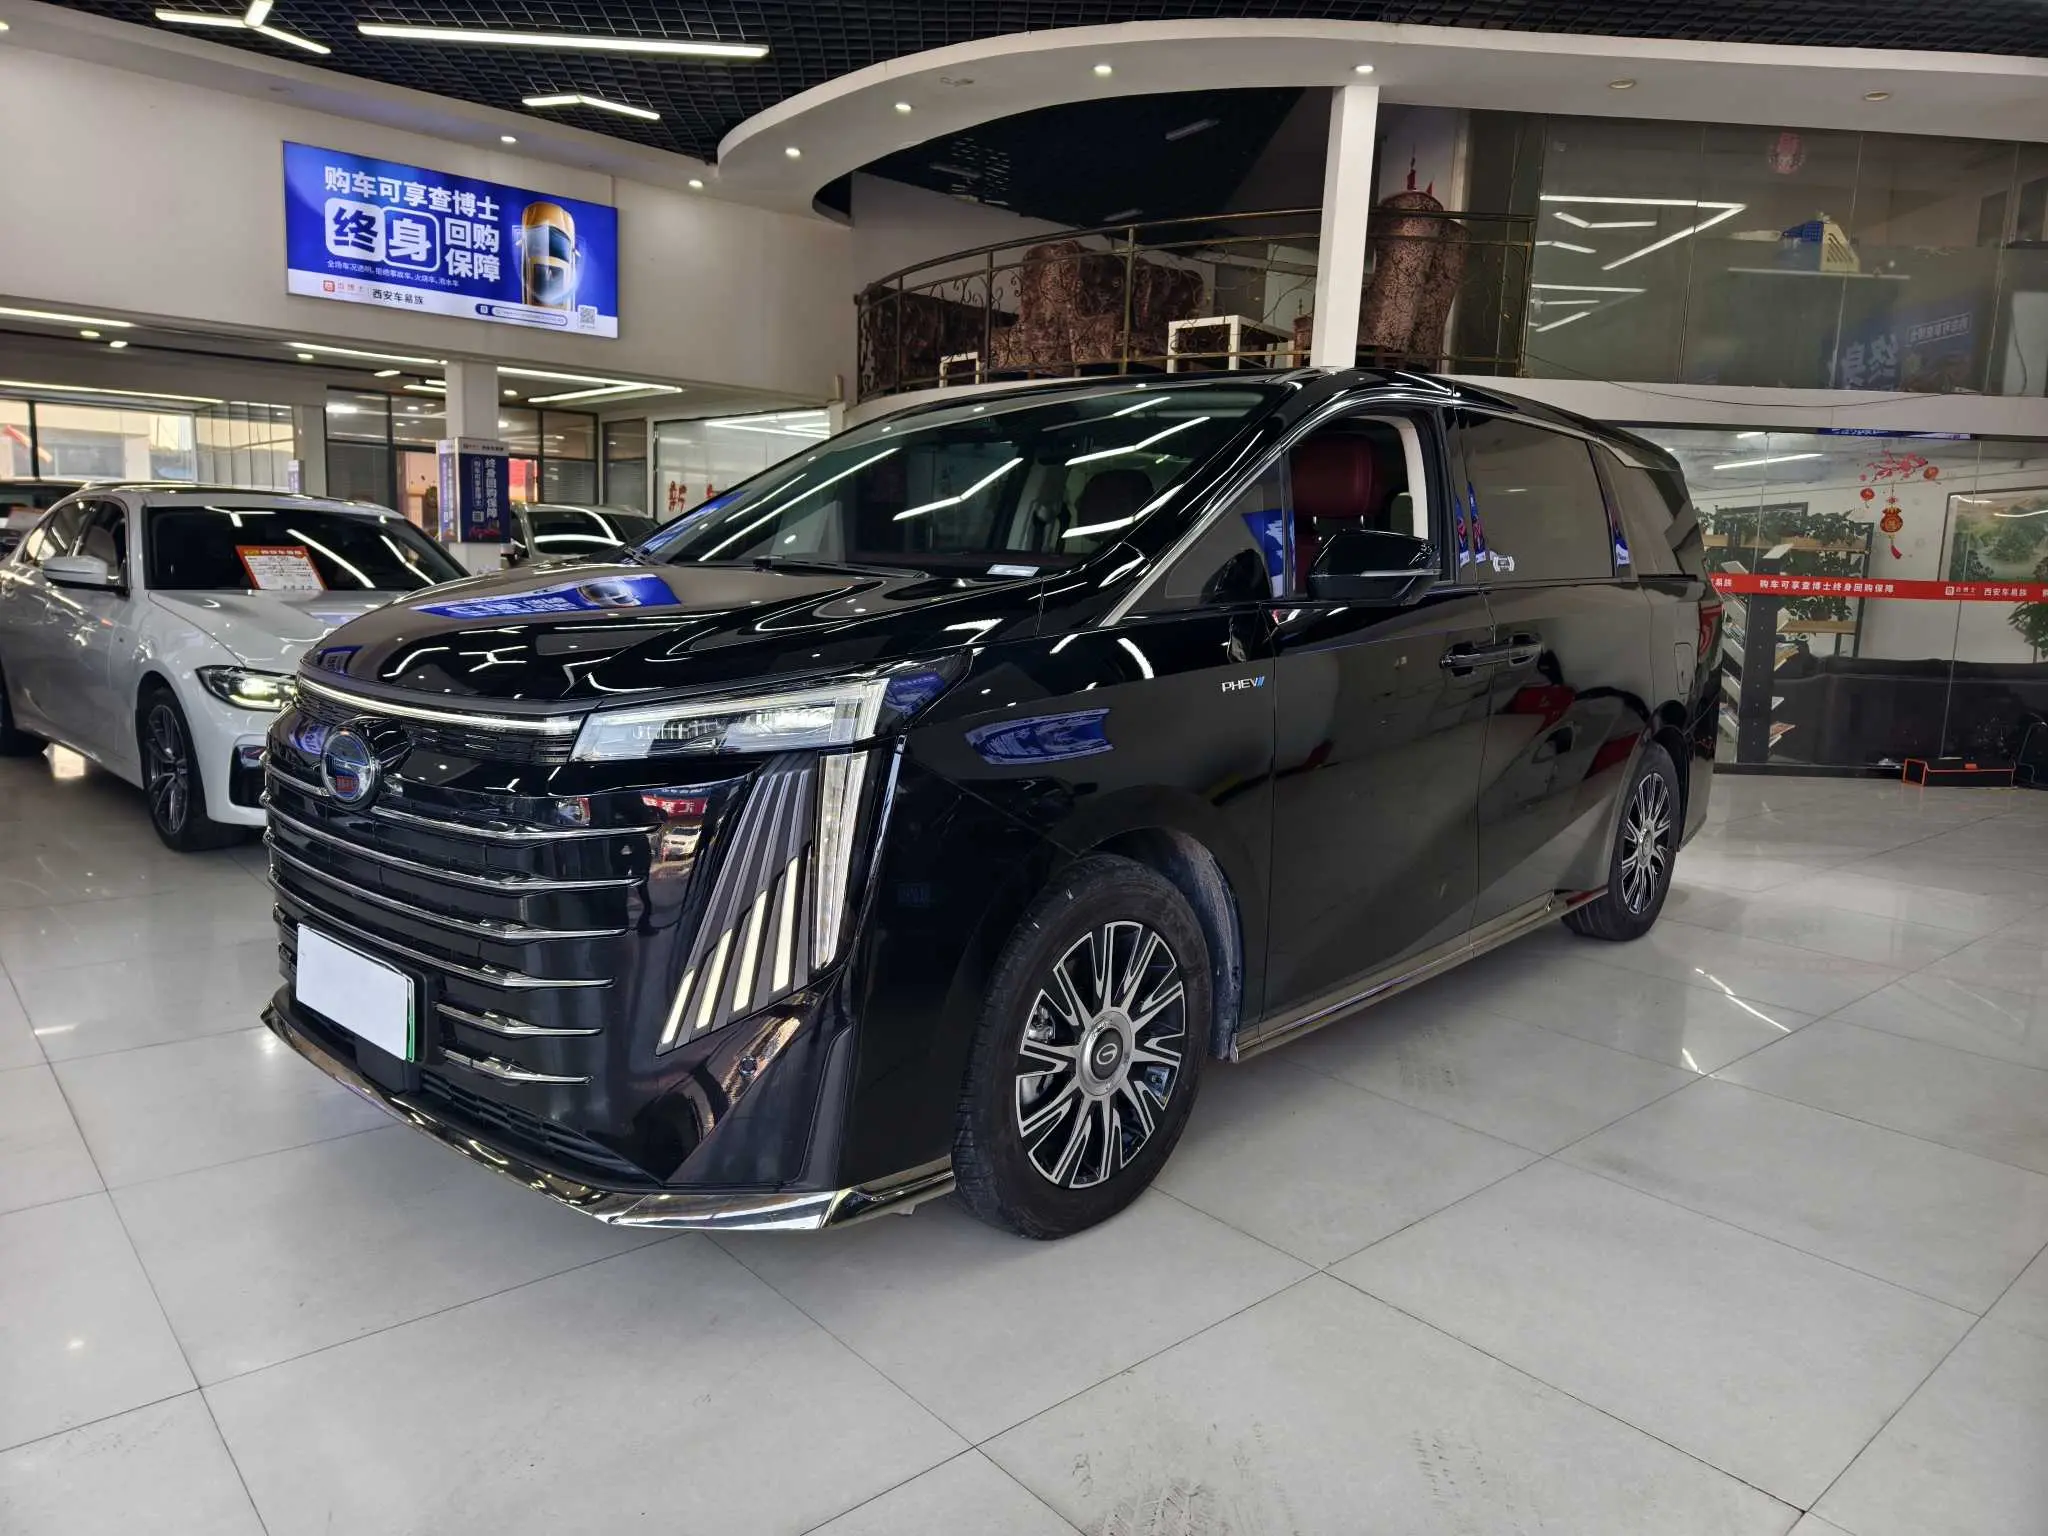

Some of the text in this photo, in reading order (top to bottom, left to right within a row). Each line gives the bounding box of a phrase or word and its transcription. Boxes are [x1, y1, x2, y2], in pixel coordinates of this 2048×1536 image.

[324, 165, 500, 222] 购车可享查博士
[332, 206, 432, 262] 终身
[444, 217, 500, 254] 回购
[444, 247, 501, 283] 保障
[1759, 579, 1894, 593] 购车可享查博士终身回购保障
[1221, 678, 1258, 693] PHEV
